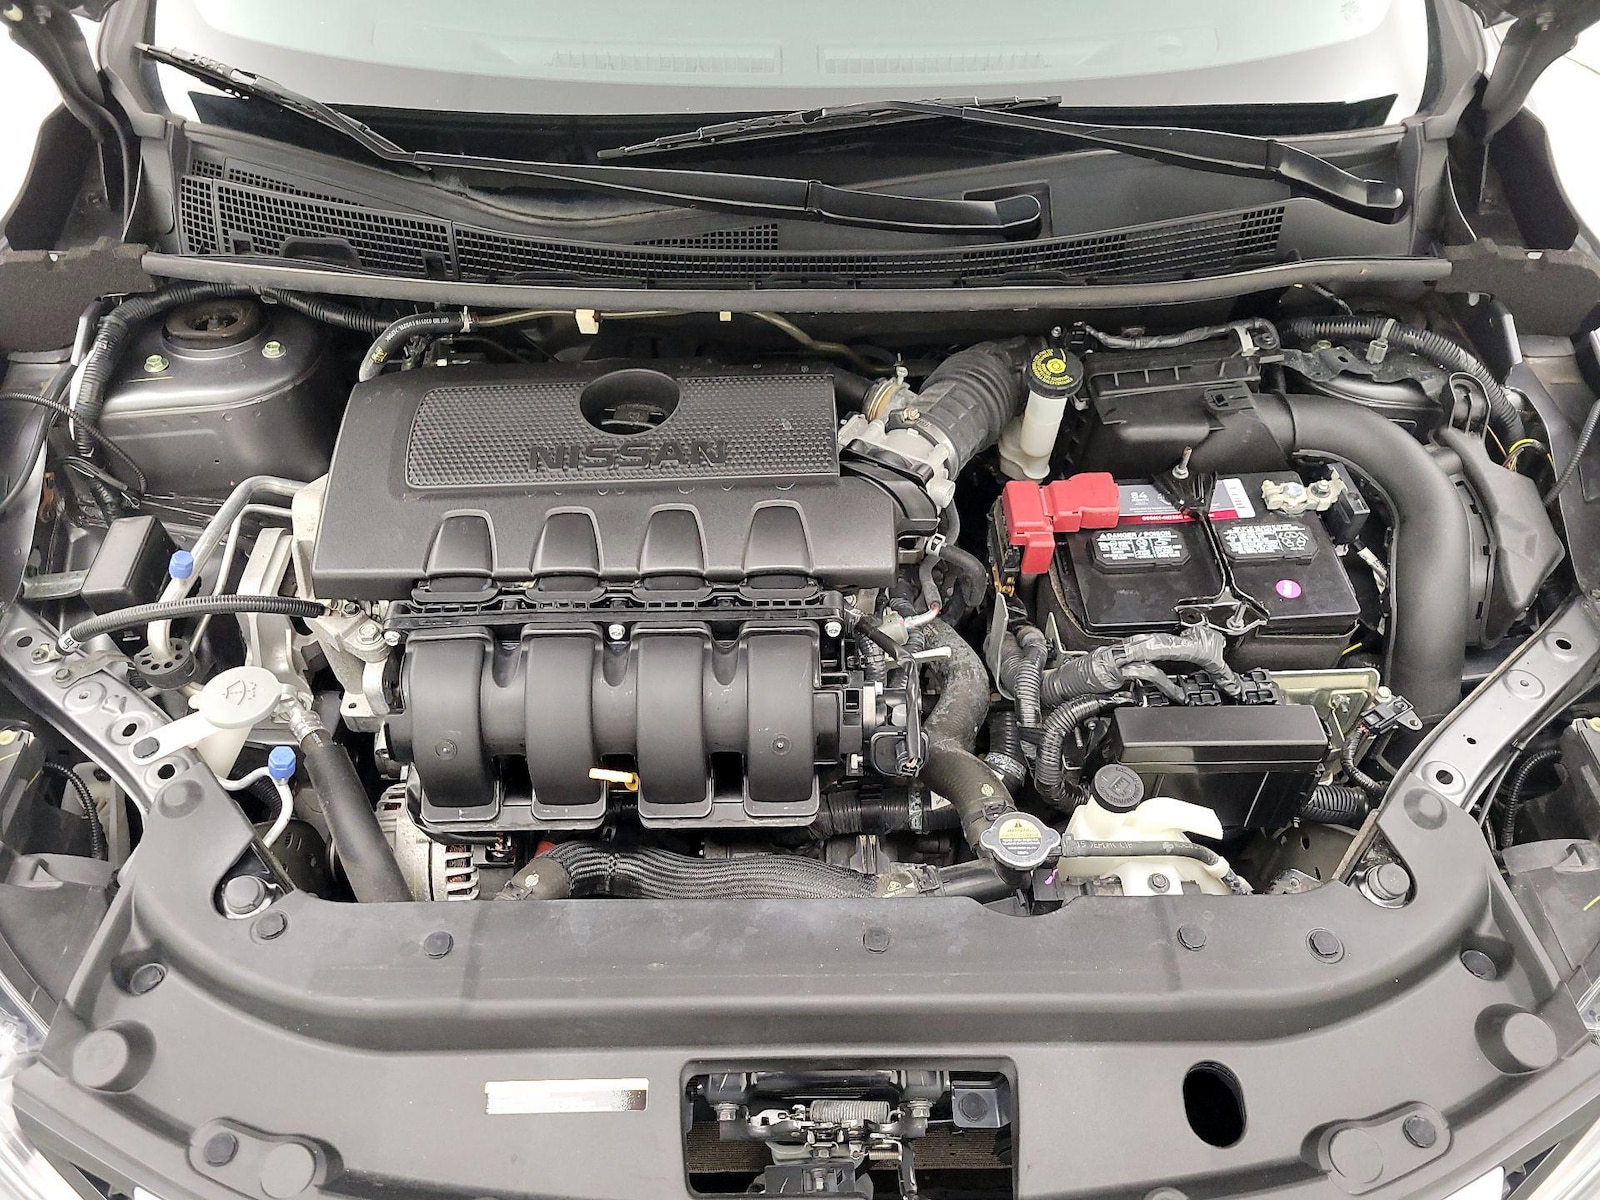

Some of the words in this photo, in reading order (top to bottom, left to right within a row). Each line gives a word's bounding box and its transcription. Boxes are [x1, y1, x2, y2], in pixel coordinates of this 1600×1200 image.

[528, 440, 726, 472] NISSAN
[1106, 531, 1137, 539] DANGER
[1143, 530, 1171, 538] POISON
